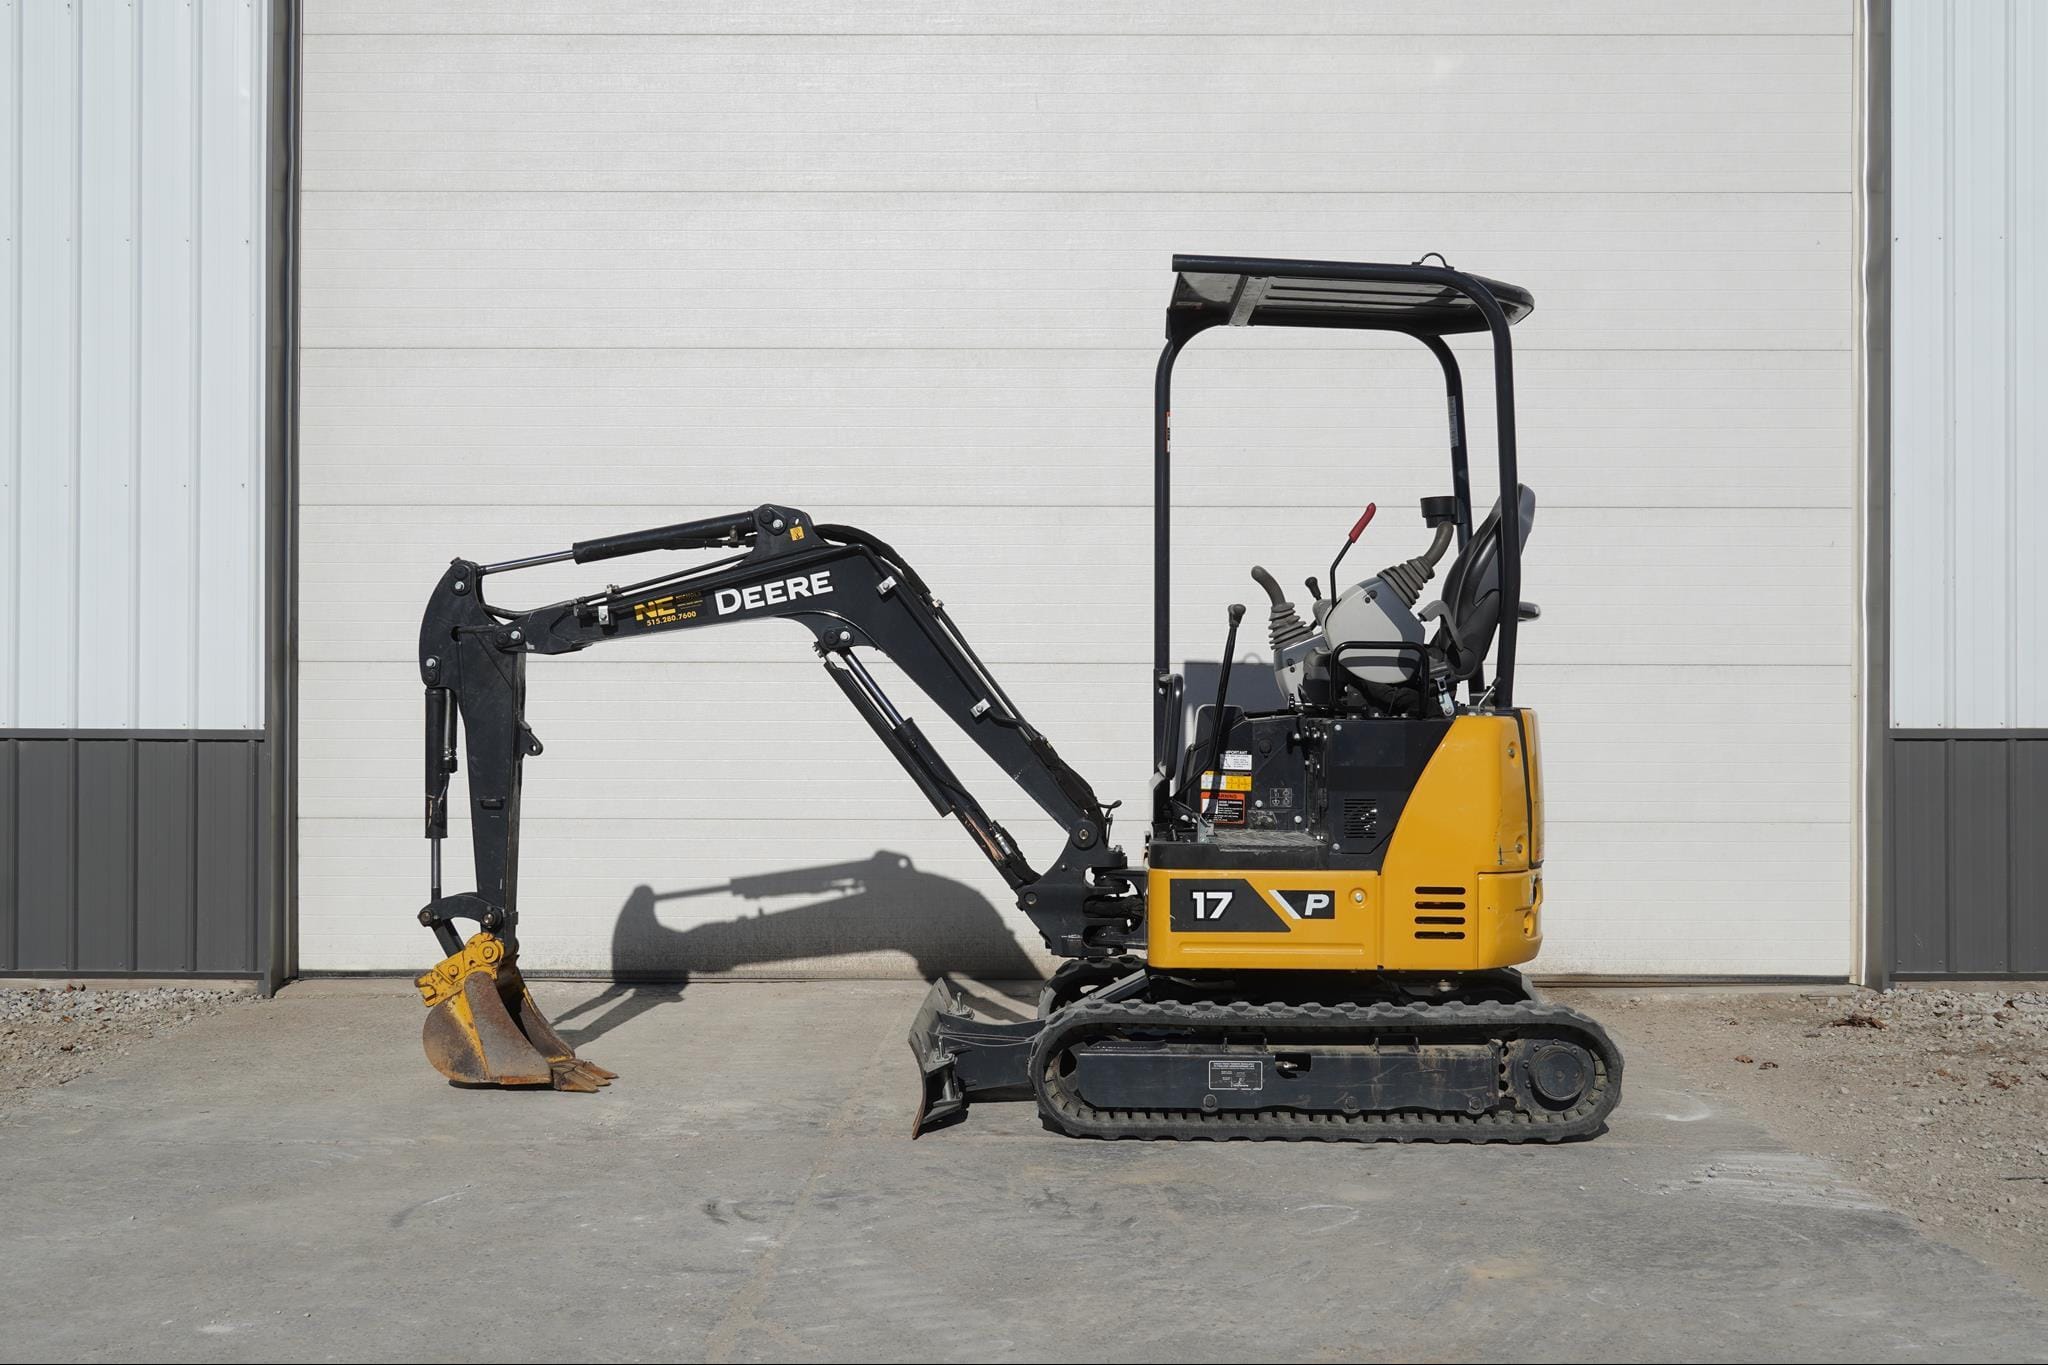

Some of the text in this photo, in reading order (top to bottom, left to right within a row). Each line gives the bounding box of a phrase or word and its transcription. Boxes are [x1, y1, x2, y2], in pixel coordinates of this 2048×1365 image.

[715, 571, 833, 615] DEERE
[634, 596, 676, 621] NE
[646, 611, 697, 626] 515.280.7600
[1192, 891, 1233, 919] 17
[1304, 893, 1330, 917] P
